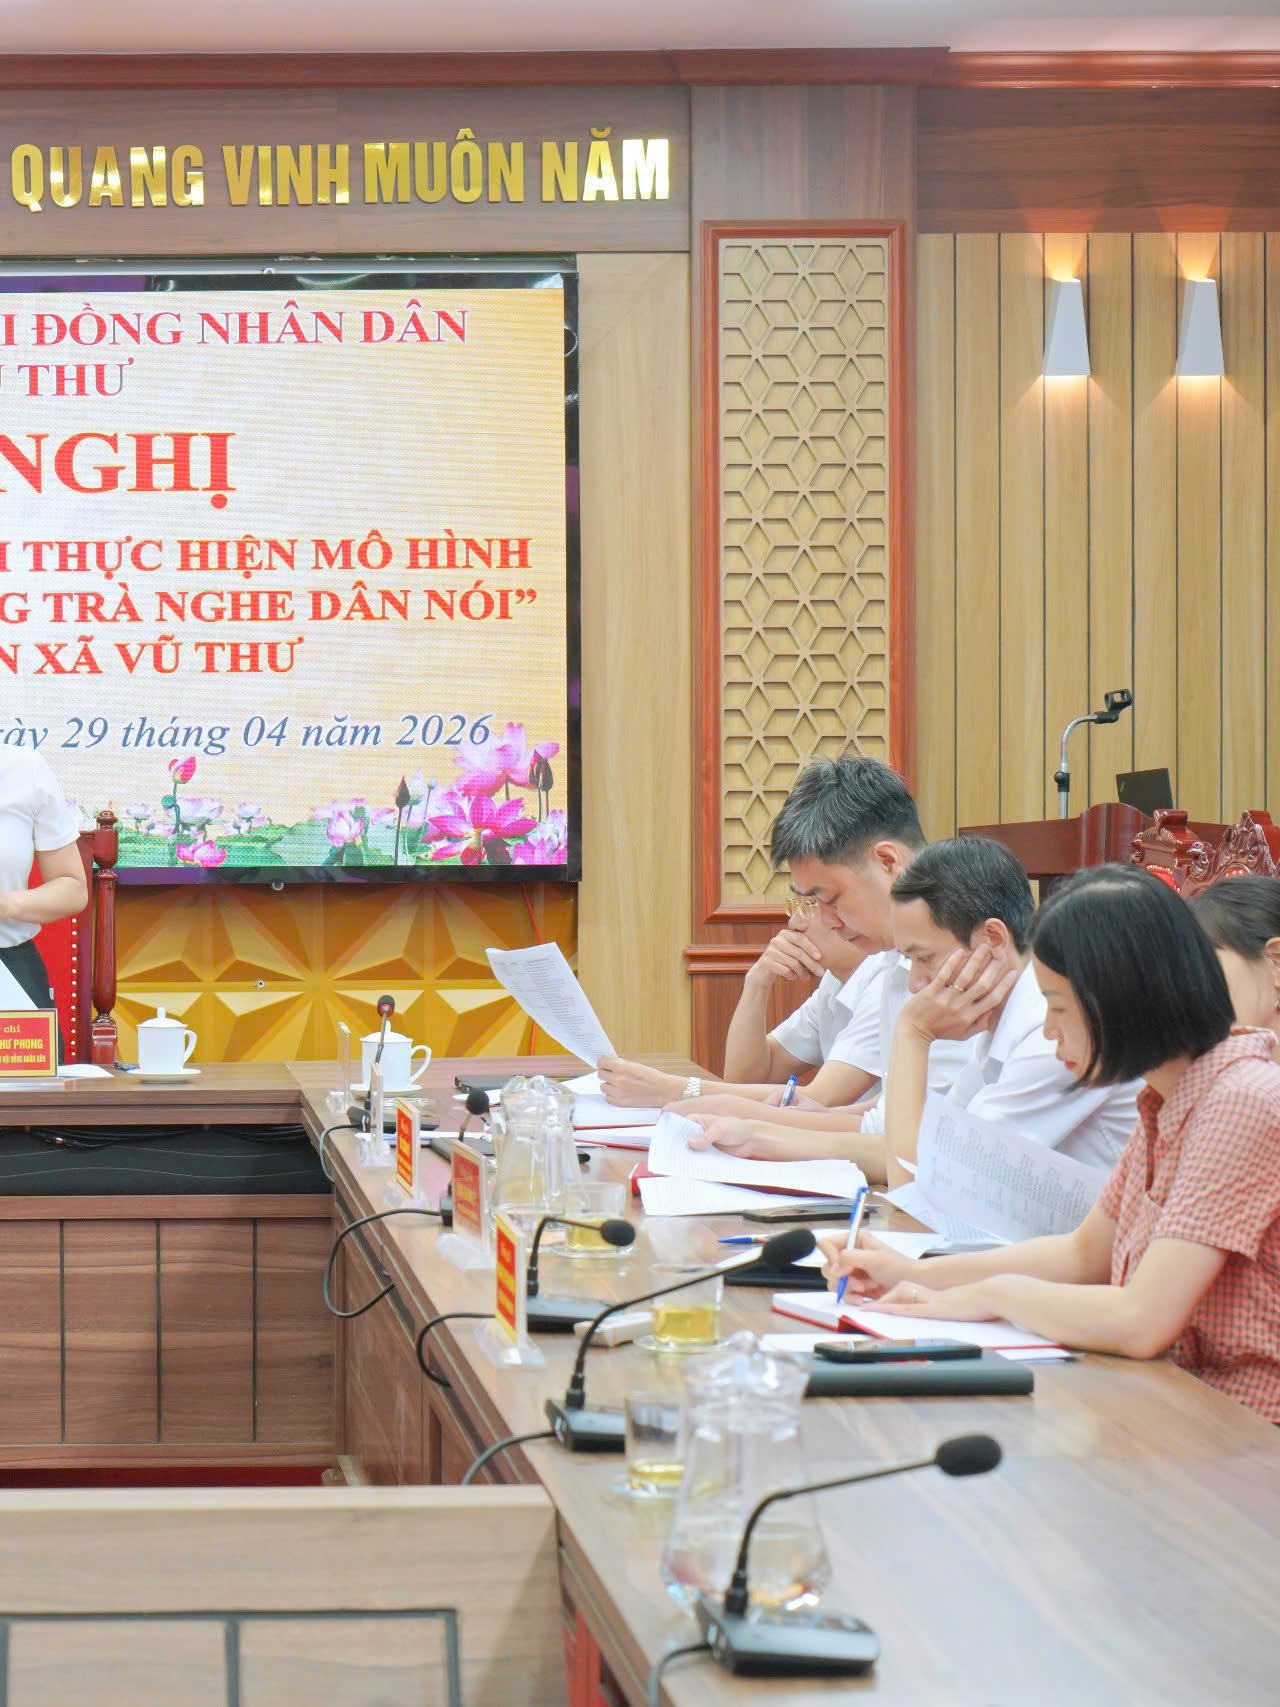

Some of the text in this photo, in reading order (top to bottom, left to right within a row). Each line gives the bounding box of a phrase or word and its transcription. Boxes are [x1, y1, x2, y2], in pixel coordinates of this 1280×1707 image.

[11, 144, 207, 213] QUANG
[221, 144, 350, 207] VINH
[363, 127, 525, 204] MUÔN
[541, 127, 670, 202] NĂM
[31, 302, 183, 346] ĐỒNG
[196, 299, 346, 345] NHÂN
[359, 298, 469, 344] DÂN
[17, 356, 134, 397] THƯ
[23, 535, 163, 580] THỰC
[176, 535, 299, 580] HIỆN
[310, 529, 394, 571] MÔ
[405, 528, 533, 569] HÌNH
[42, 581, 143, 622] TRÀ
[156, 590, 295, 622] NGHE
[308, 580, 411, 621] DÂN
[33, 634, 103, 675] XÃ
[114, 634, 182, 674] VŨ
[195, 636, 304, 674] THƯ
[60, 716, 109, 749] 29
[122, 716, 230, 756] tháng
[243, 715, 288, 747] 04
[301, 715, 382, 747] năm
[395, 713, 493, 747] 2026
[3, 1024, 21, 1033] chí
